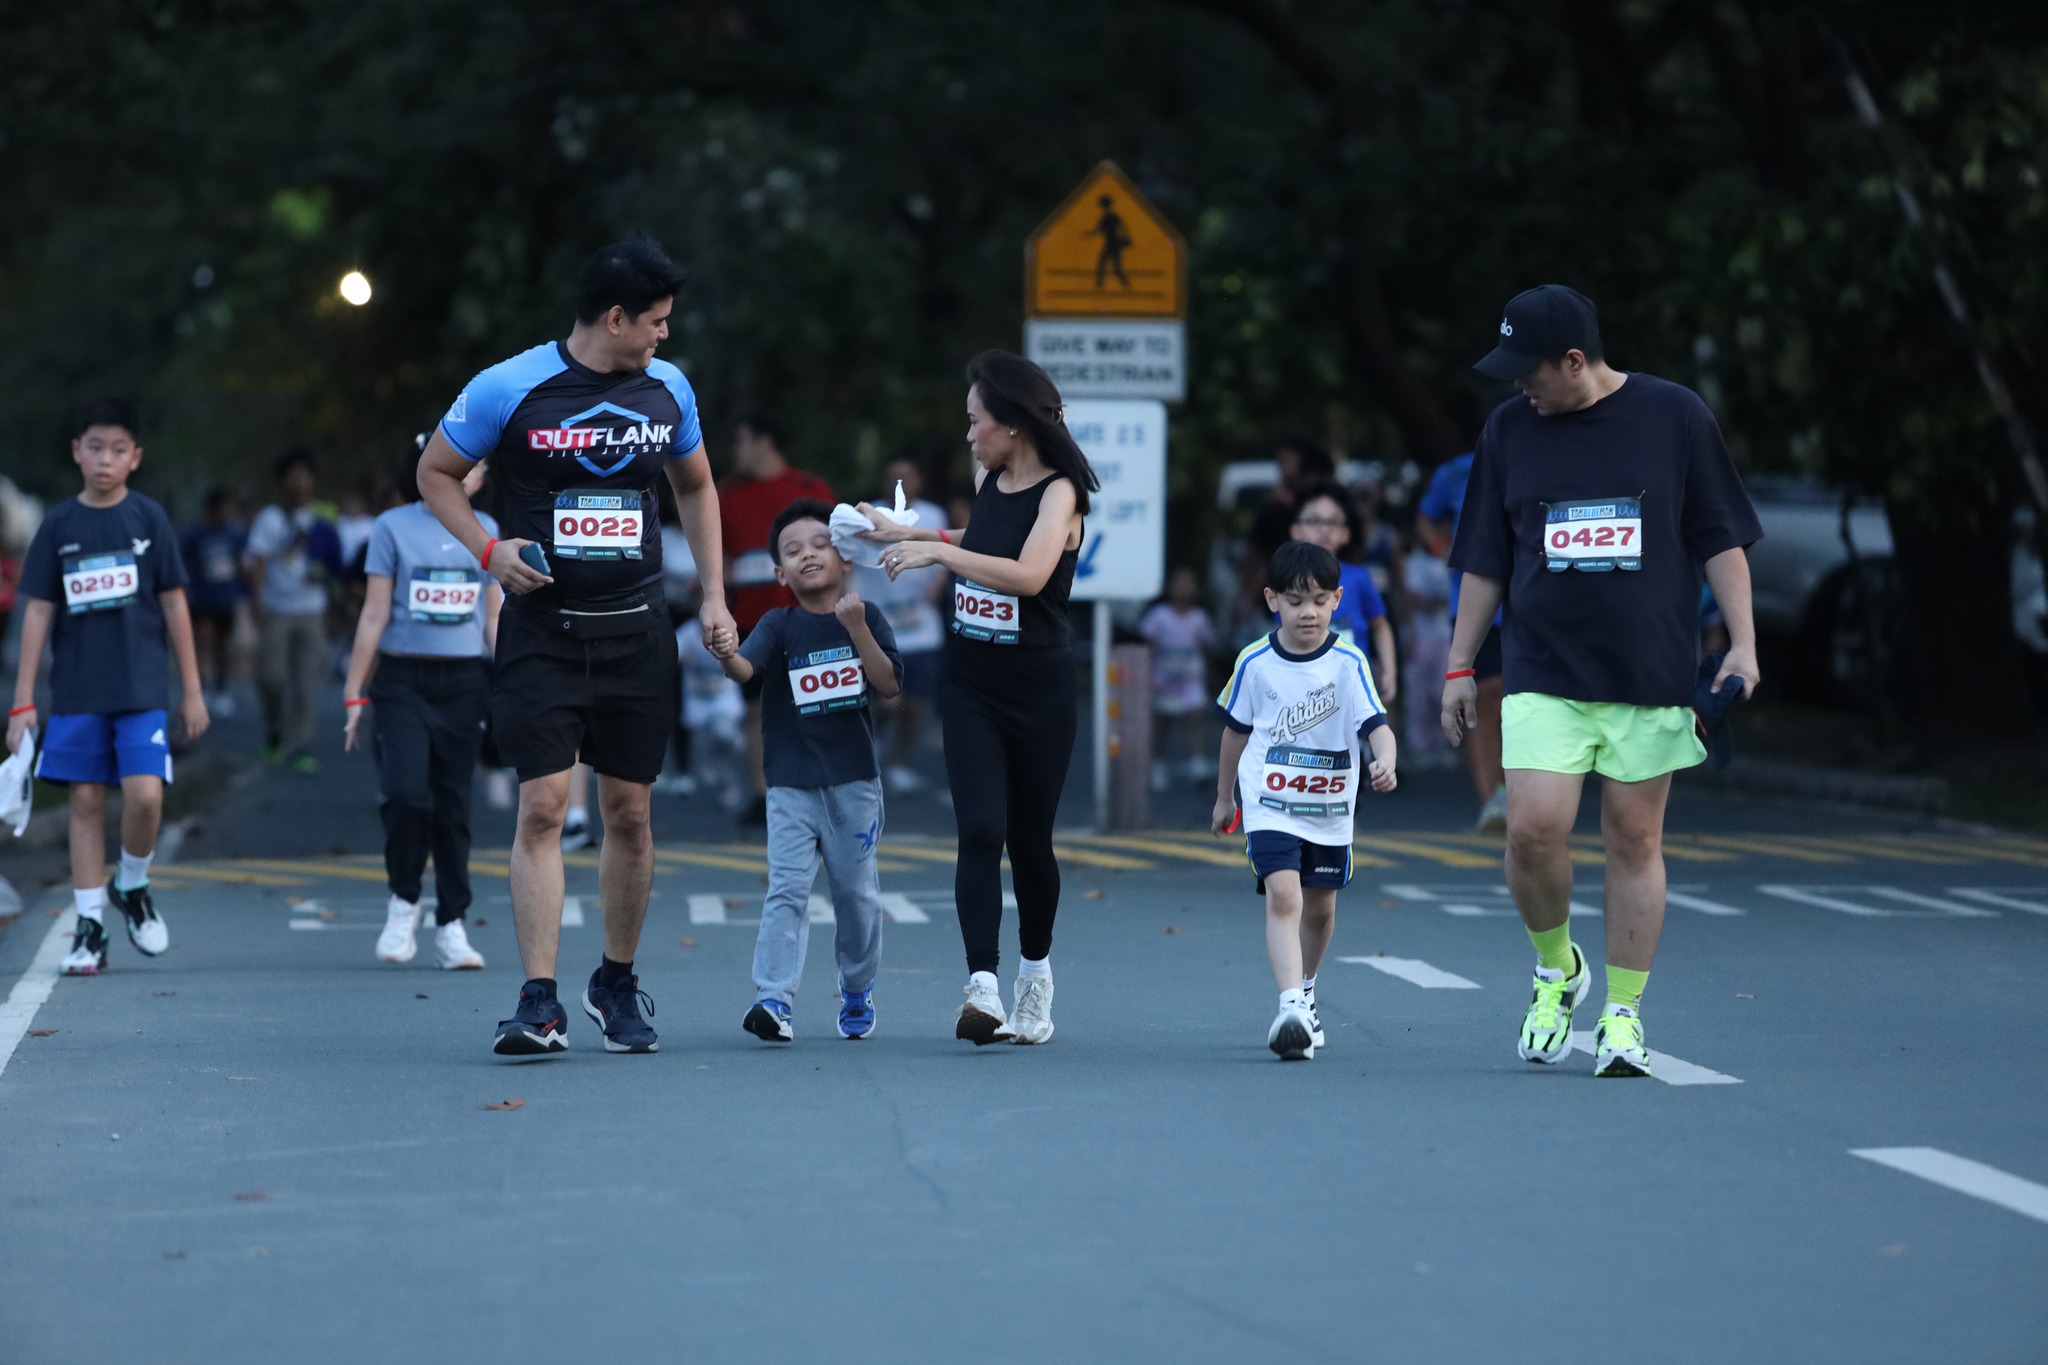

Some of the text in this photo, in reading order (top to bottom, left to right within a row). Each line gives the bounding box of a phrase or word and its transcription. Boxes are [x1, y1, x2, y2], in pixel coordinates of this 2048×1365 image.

[1040, 335, 1170, 354] GIVE WAY TO
[531, 423, 674, 449] OUTFLANK
[548, 445, 663, 458] JIU JITSU
[559, 517, 638, 537] 0022
[1551, 526, 1635, 549] 0427
[70, 572, 132, 594] 0293
[416, 588, 475, 605] 0292
[957, 592, 1014, 621] 0023
[1306, 681, 1335, 698] Originals
[1269, 690, 1337, 744] Adidas
[1266, 772, 1346, 794] 0425
